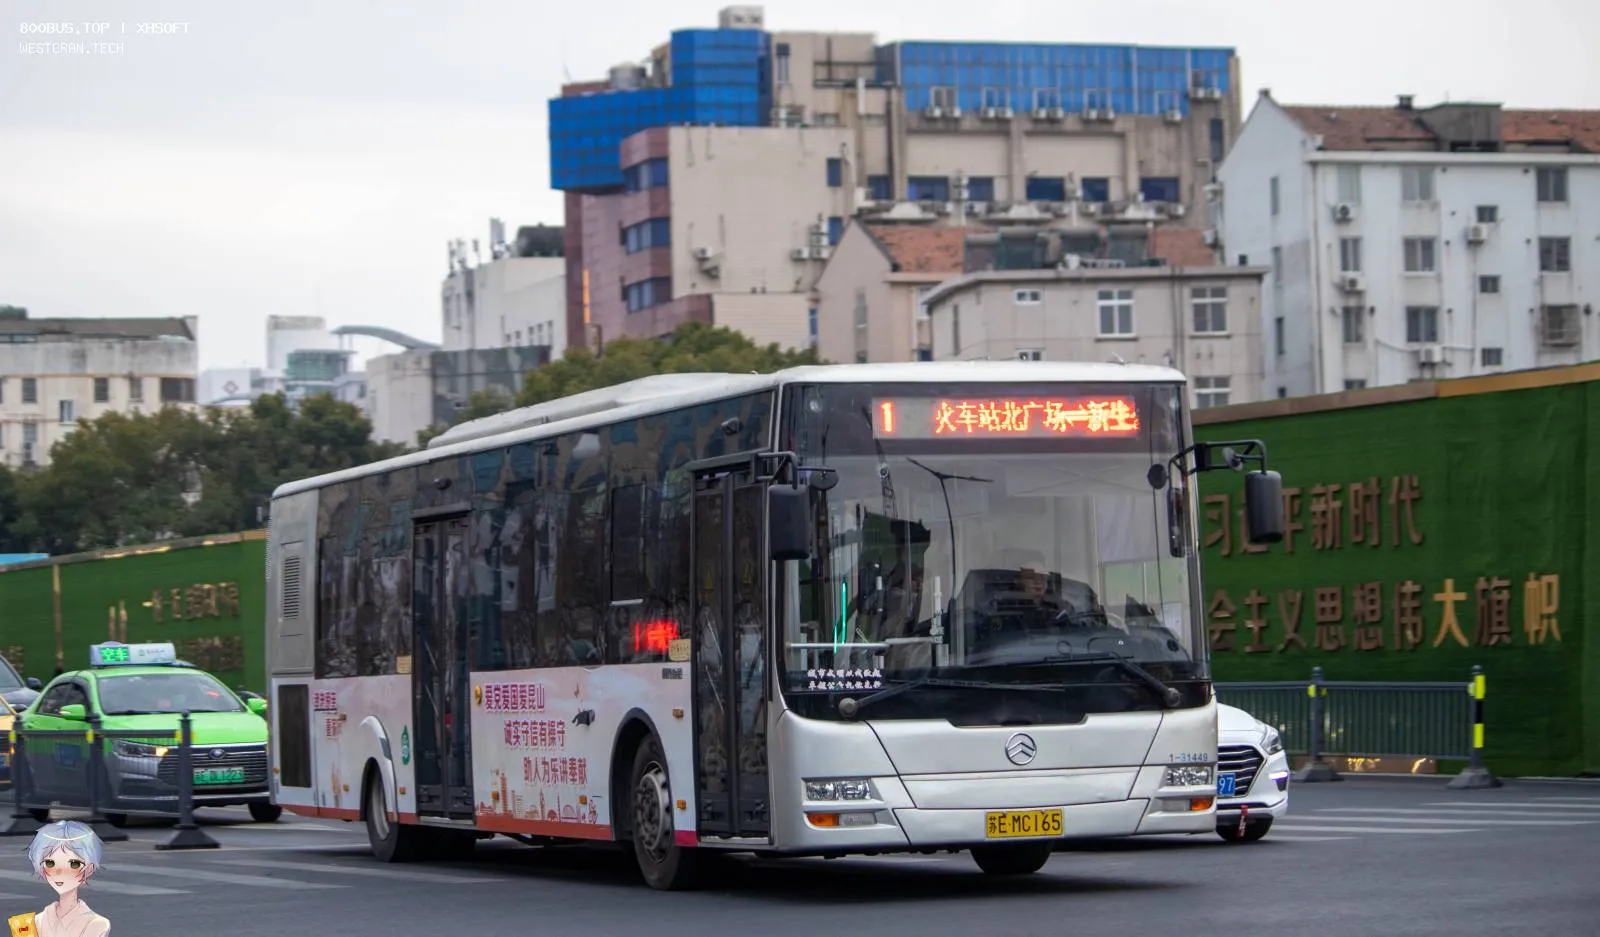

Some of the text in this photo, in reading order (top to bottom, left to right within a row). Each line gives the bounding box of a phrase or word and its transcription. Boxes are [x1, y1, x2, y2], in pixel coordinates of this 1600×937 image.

[1203, 475, 1424, 557] 习平新时代
[1209, 572, 1562, 653] 会主义思想伟大旗帜
[485, 683, 545, 711] 爱党爱国爱昆山
[503, 720, 566, 748] 诚实守信有操守
[523, 756, 588, 785] 助人为乐讲奉献
